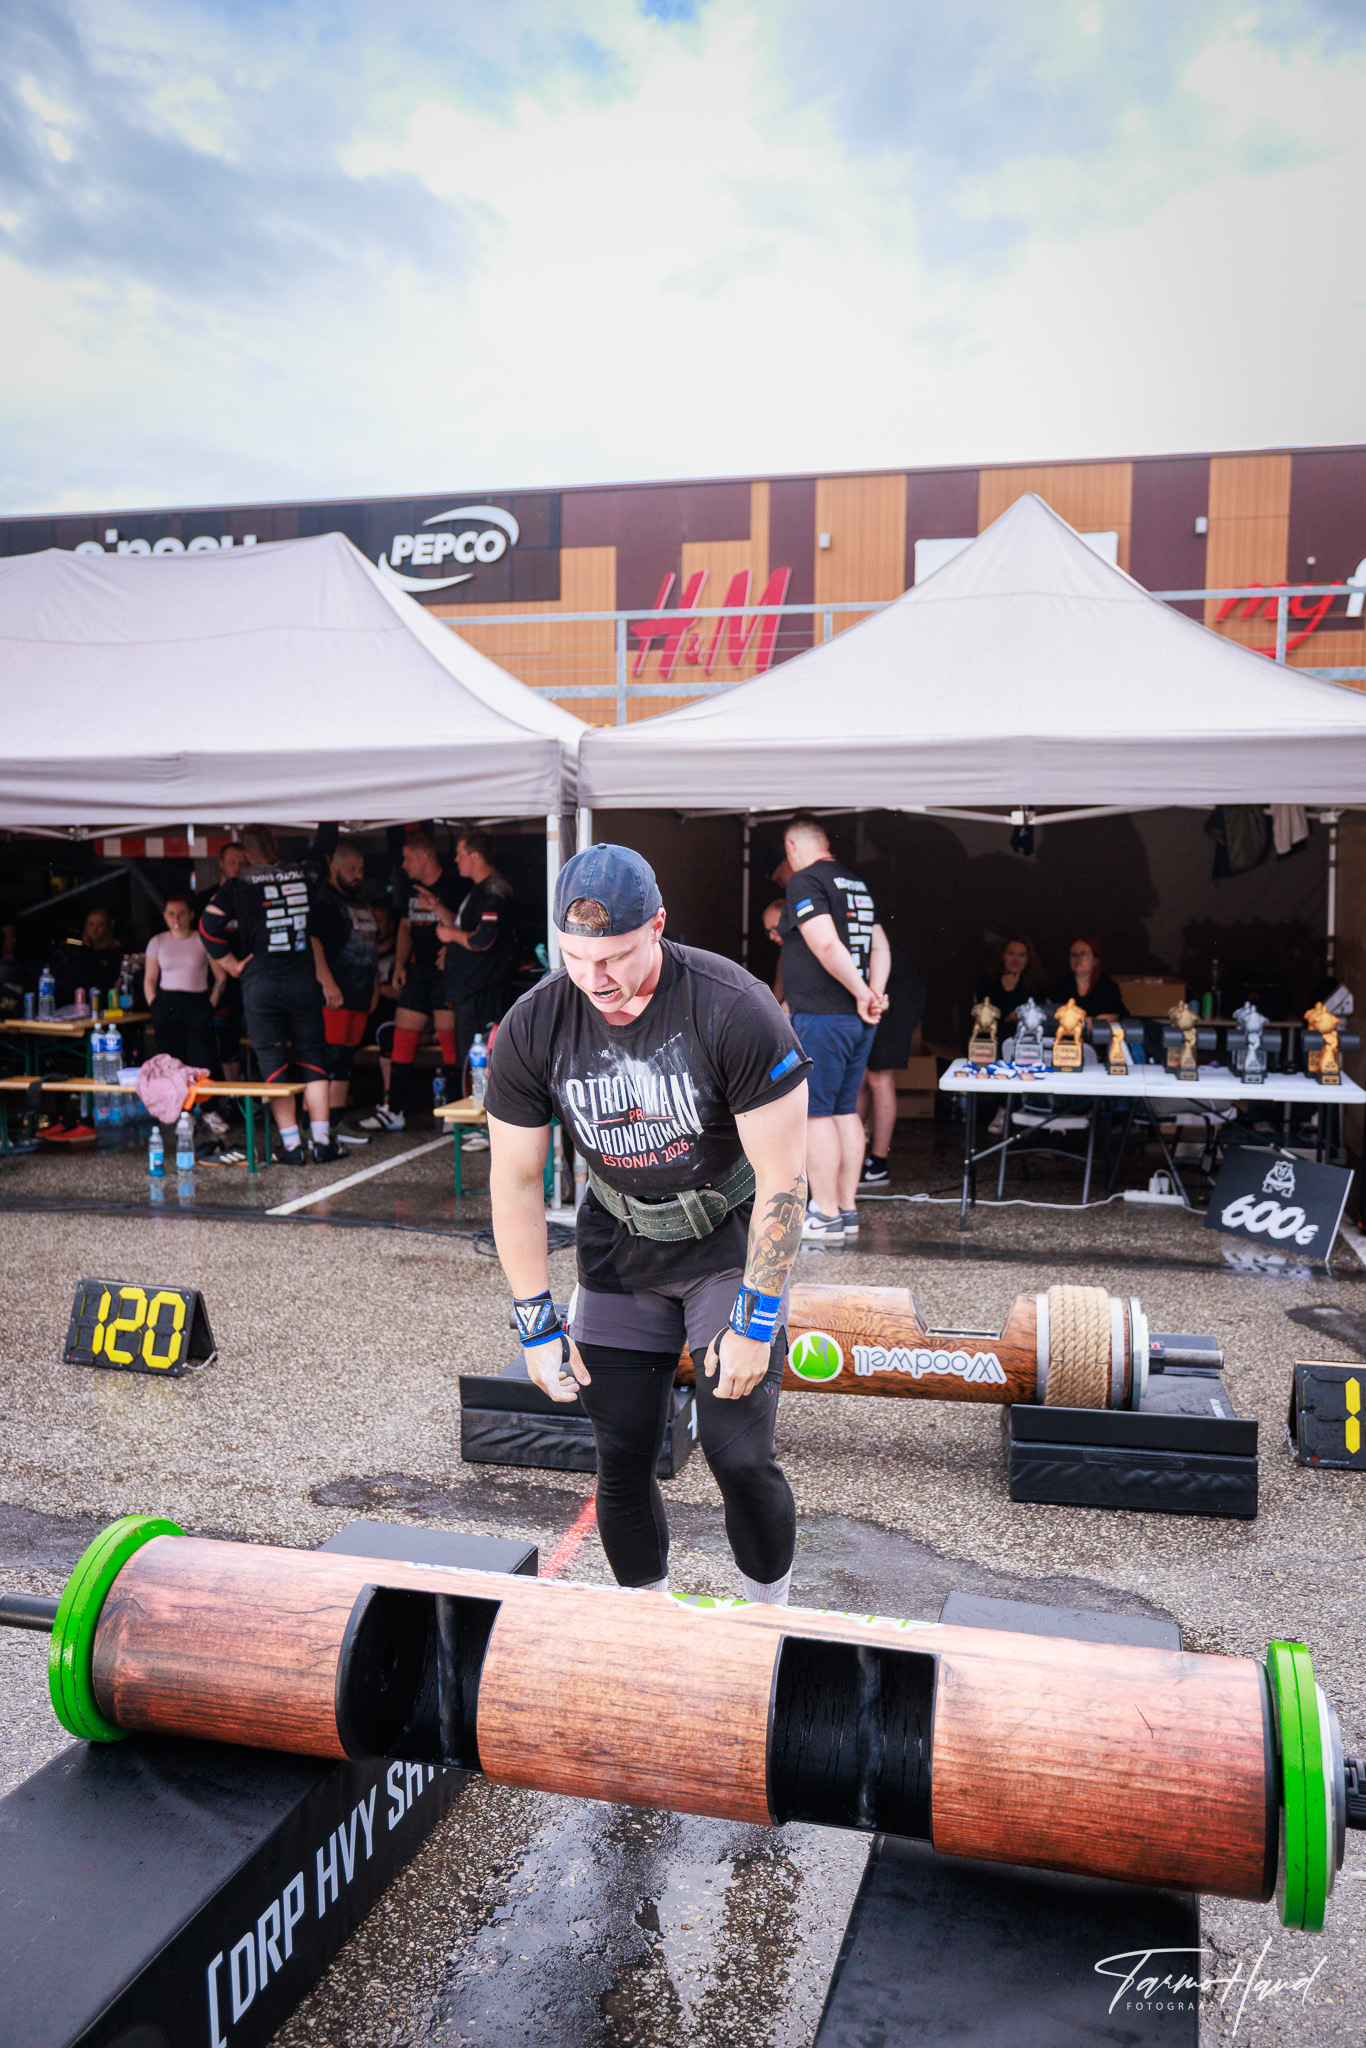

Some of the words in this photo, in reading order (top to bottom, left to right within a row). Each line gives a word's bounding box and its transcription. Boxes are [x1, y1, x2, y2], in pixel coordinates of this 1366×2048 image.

[390, 529, 507, 567] PEPCO
[629, 566, 792, 681] H&M
[628, 1108, 646, 1123] PR
[601, 1153, 660, 1169] ESTONIA
[661, 1137, 691, 1164] 2026
[1221, 1193, 1320, 1246] 600€
[91, 1285, 187, 1370] 120
[854, 1348, 1004, 1382] Woodwell
[316, 1784, 377, 1920] HVY
